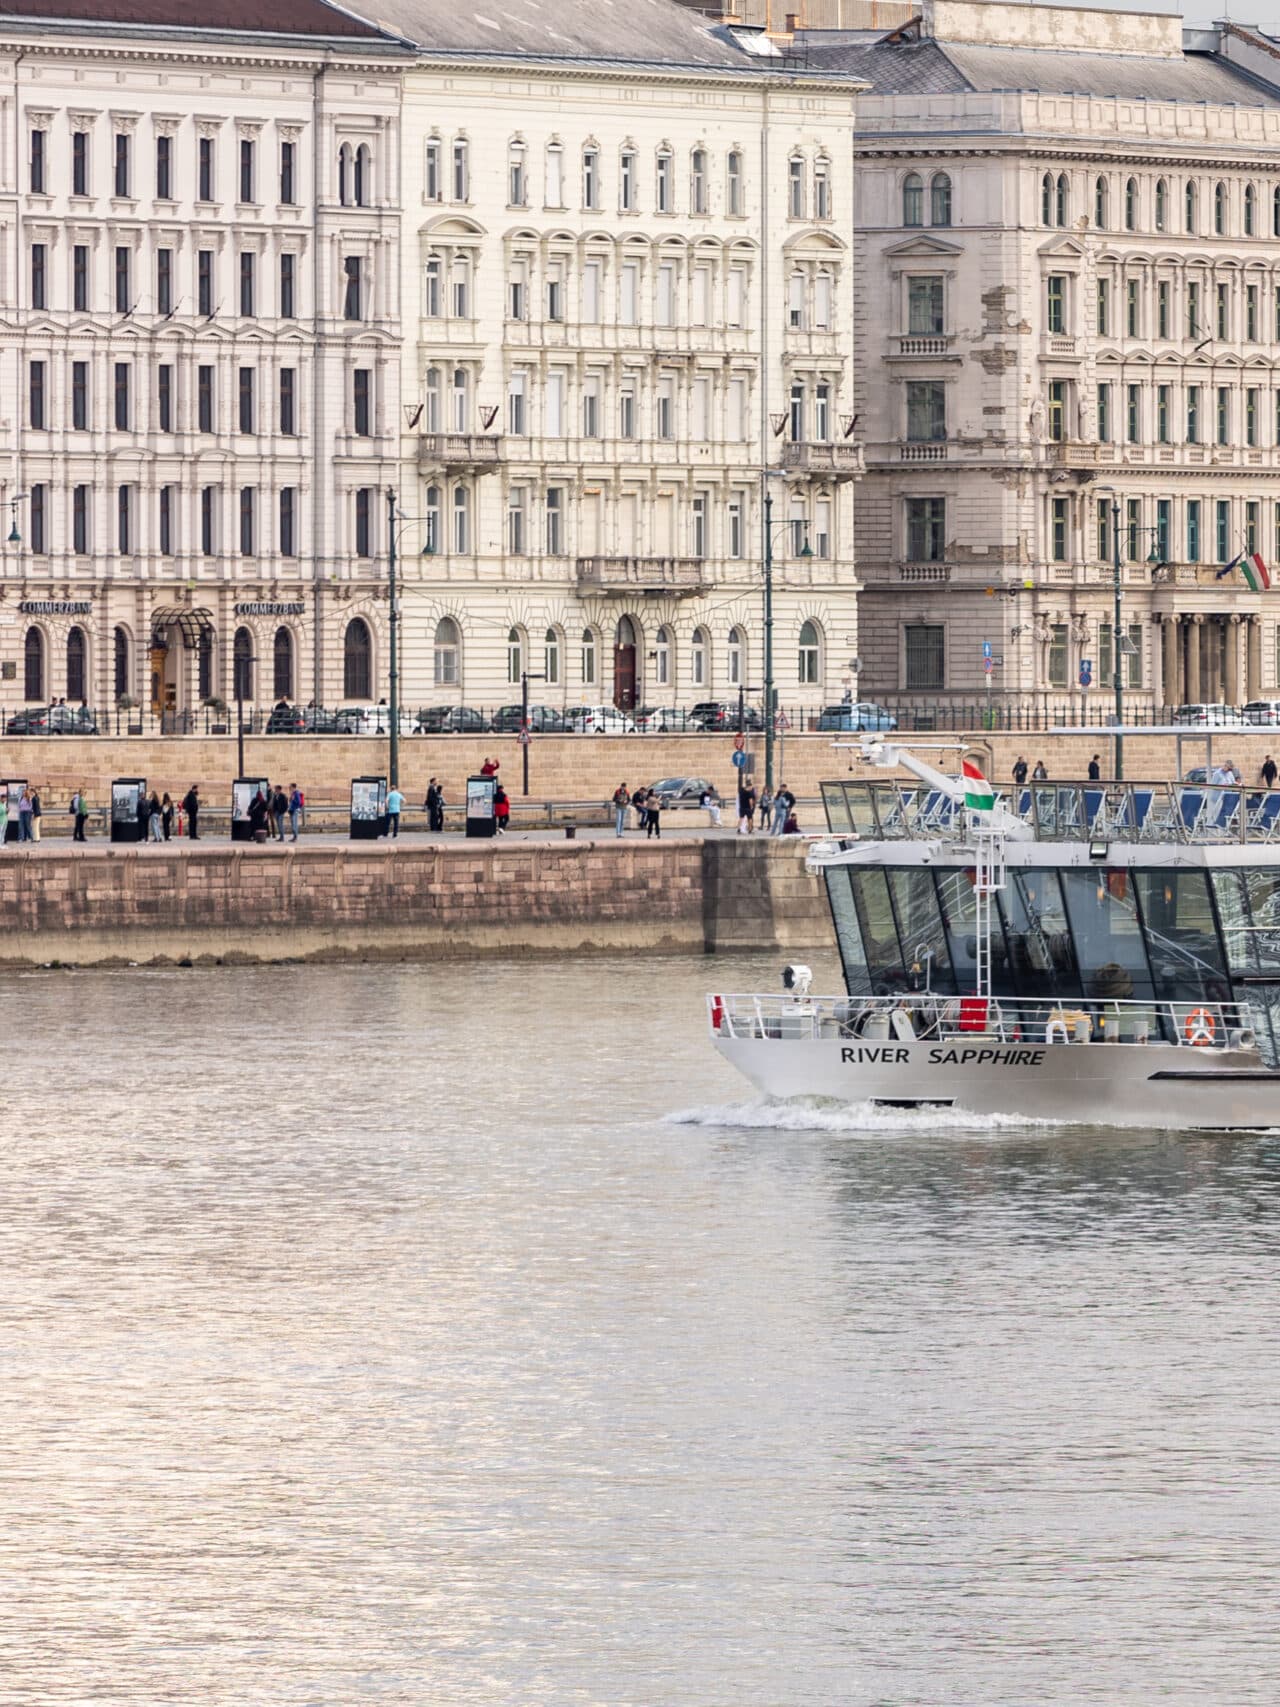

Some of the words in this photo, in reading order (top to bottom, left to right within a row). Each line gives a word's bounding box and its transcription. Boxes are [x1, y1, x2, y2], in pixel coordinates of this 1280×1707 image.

[21, 602, 92, 614] COMMERZBANK
[841, 1047, 910, 1063] RIVER
[928, 1049, 1046, 1065] SAPPHIRE
